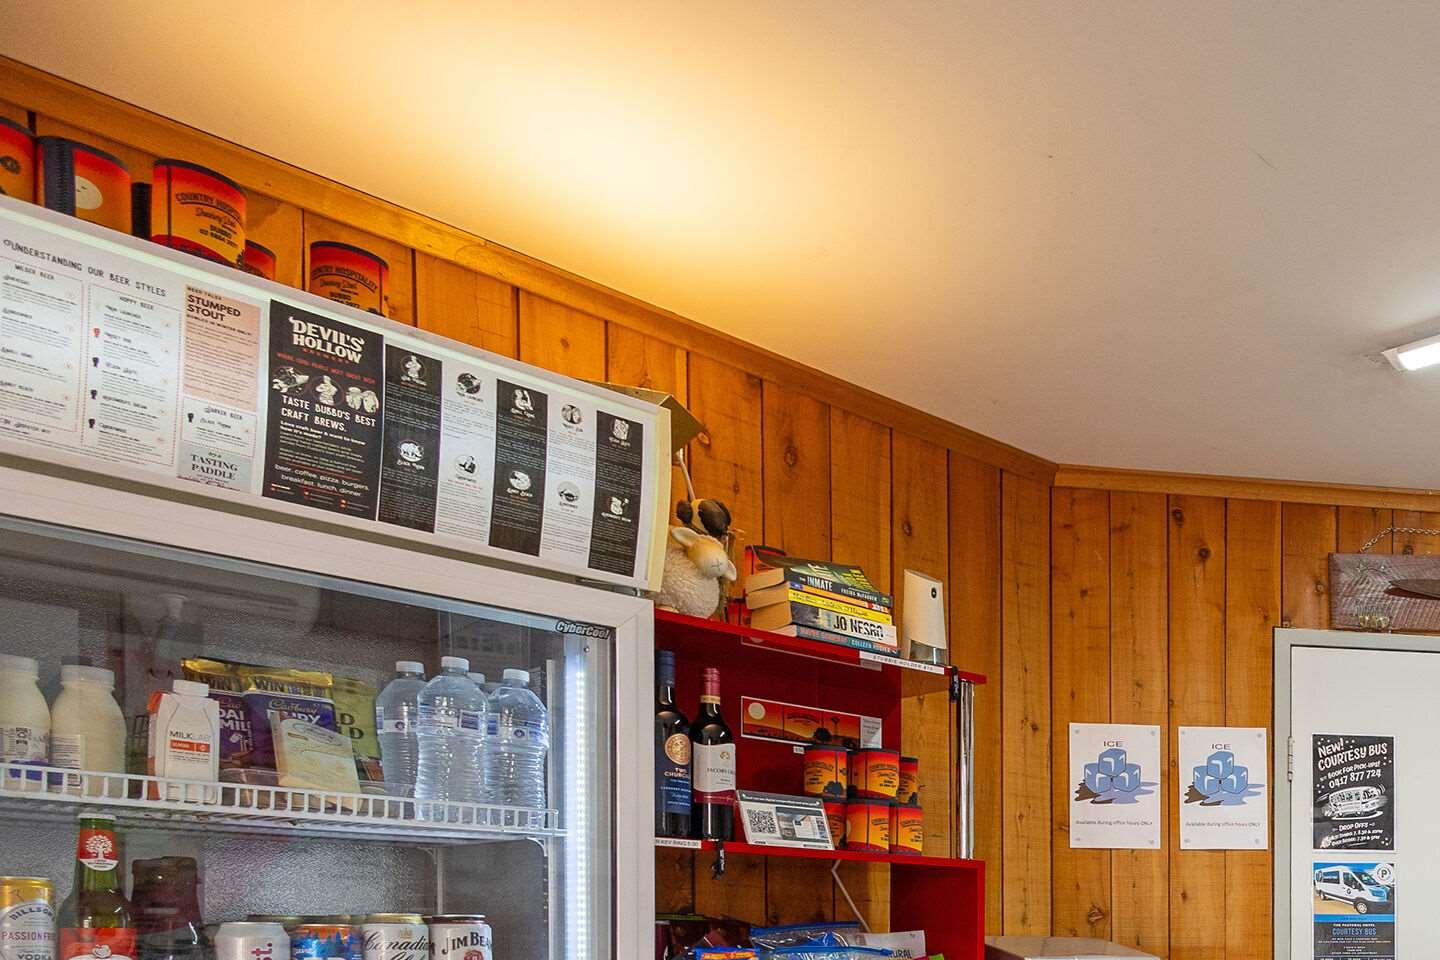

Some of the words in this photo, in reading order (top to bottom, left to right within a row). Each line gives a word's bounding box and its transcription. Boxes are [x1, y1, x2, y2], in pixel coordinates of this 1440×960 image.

[11, 242, 83, 272] UNDERSTANDING
[88, 266, 104, 279] OUR
[109, 273, 130, 286] BEER
[135, 281, 167, 297] STYLES
[187, 294, 242, 317] STUMPED
[187, 304, 225, 321] STOUT
[288, 316, 365, 352] DEVIL'S
[293, 333, 362, 364] HOLLOW
[281, 408, 309, 423] CRAFT
[282, 395, 310, 411] TASTE
[355, 414, 376, 428] BEST
[191, 453, 238, 471] TASTING
[192, 463, 236, 481] PADDLE
[807, 576, 833, 592] INMATE
[833, 616, 848, 632] JO
[1103, 740, 1124, 748] ICE
[1318, 738, 1345, 758] NEW!
[1318, 746, 1367, 771] COURTESY
[1368, 743, 1388, 757] BUS
[1349, 771, 1365, 782] 877
[1366, 769, 1381, 780] 724
[441, 935, 469, 955] JIM
